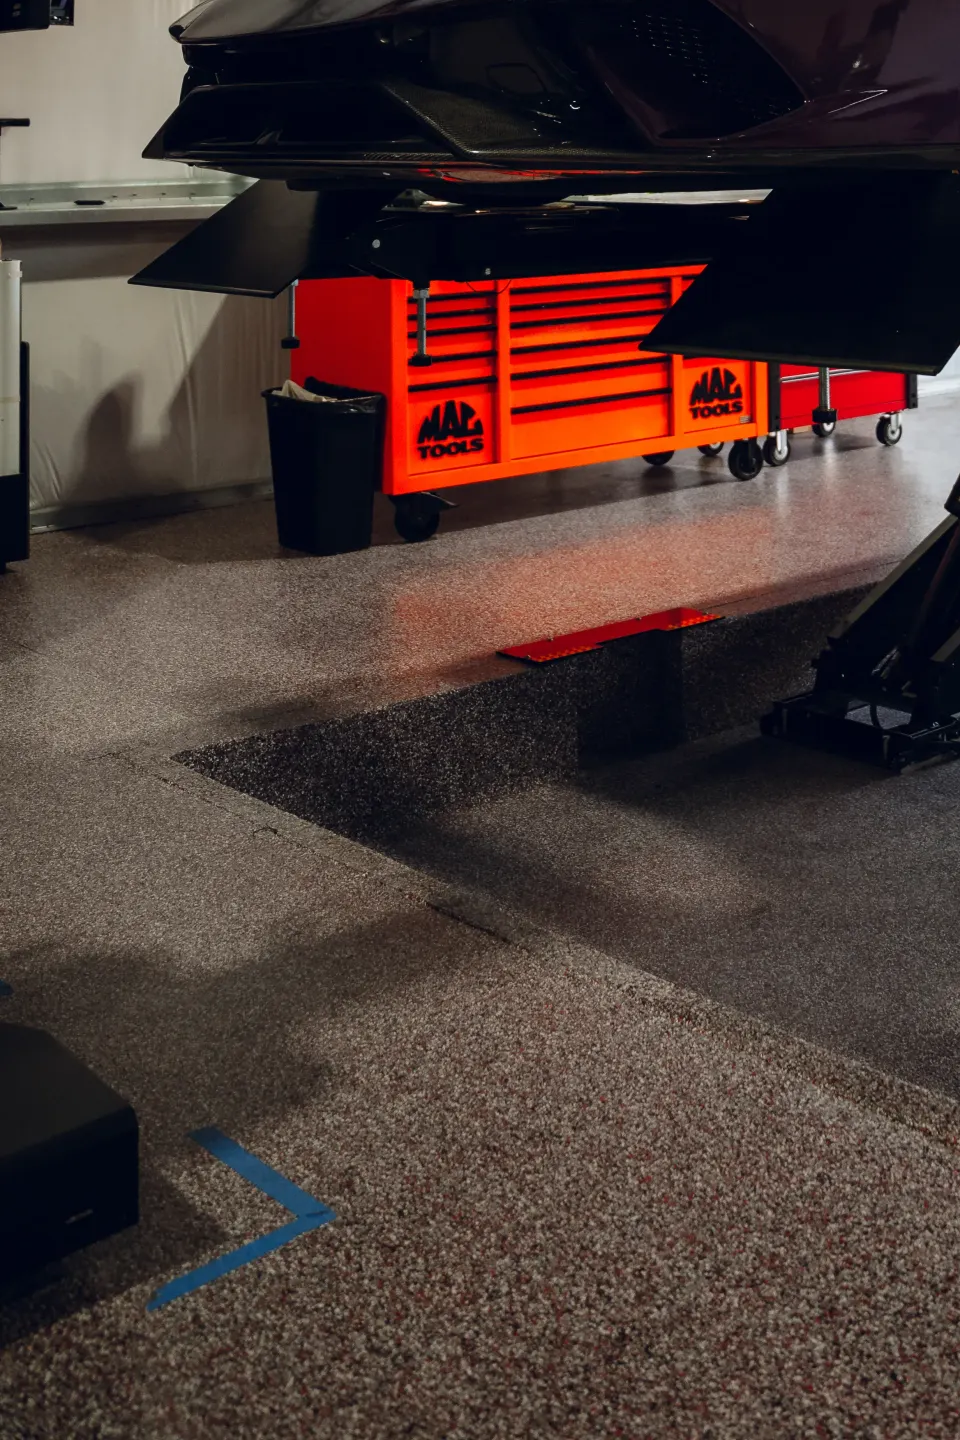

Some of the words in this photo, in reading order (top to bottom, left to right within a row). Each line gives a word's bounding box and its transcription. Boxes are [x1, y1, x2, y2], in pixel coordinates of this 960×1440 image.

[689, 367, 743, 406] MAC
[416, 400, 484, 444] MAC
[688, 401, 743, 420] TOOLS
[416, 438, 484, 459] TOOLS
